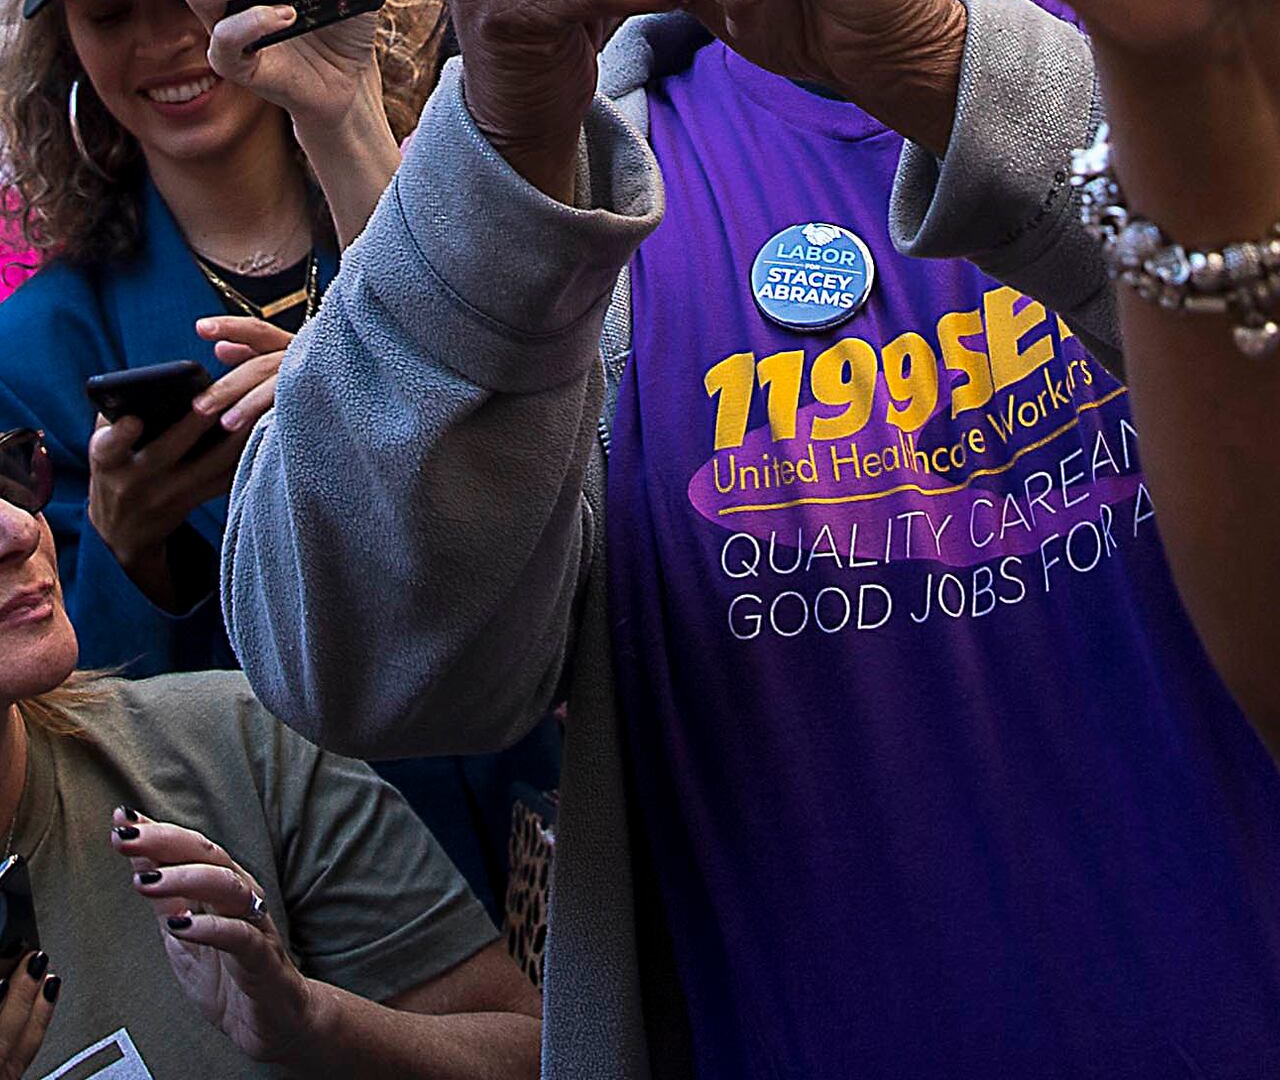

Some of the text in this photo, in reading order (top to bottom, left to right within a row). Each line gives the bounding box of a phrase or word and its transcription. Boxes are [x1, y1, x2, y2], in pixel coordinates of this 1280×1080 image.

[767, 267, 853, 291] STACEY
[776, 243, 856, 266] LABOR
[805, 263, 821, 271] FOR
[758, 283, 855, 309] ABRAMS
[704, 286, 1073, 451] 1199SE
[713, 356, 1094, 495] United Healhcare Workrs
[721, 509, 952, 579] QUALITY
[1091, 418, 1139, 476] AN
[727, 582, 893, 640] GOOD
[910, 555, 1026, 624] JOBS
[1040, 503, 1118, 592] FOR
